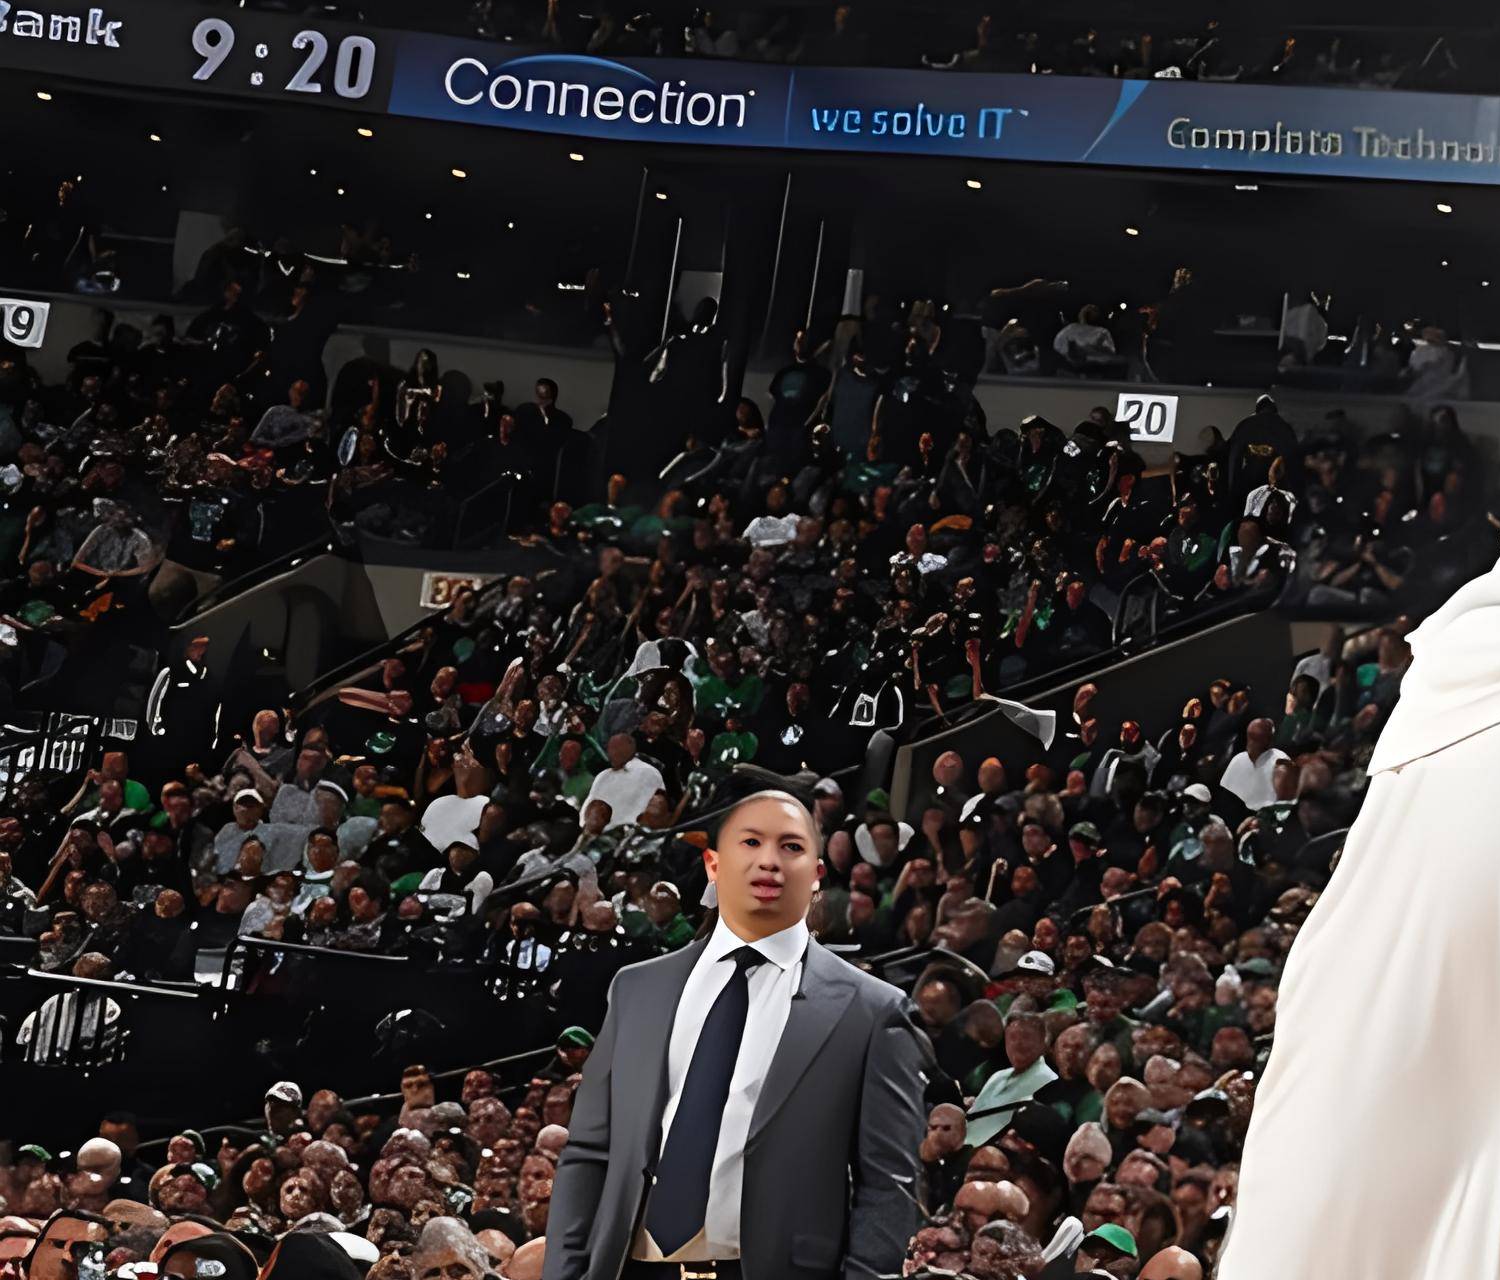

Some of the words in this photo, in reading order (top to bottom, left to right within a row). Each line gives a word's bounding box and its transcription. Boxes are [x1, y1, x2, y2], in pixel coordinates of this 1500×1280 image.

[191, 18, 377, 99] 9:20
[444, 57, 748, 128] Connection
[811, 106, 861, 135] we
[872, 103, 966, 138] solve
[1125, 400, 1167, 436] 20
